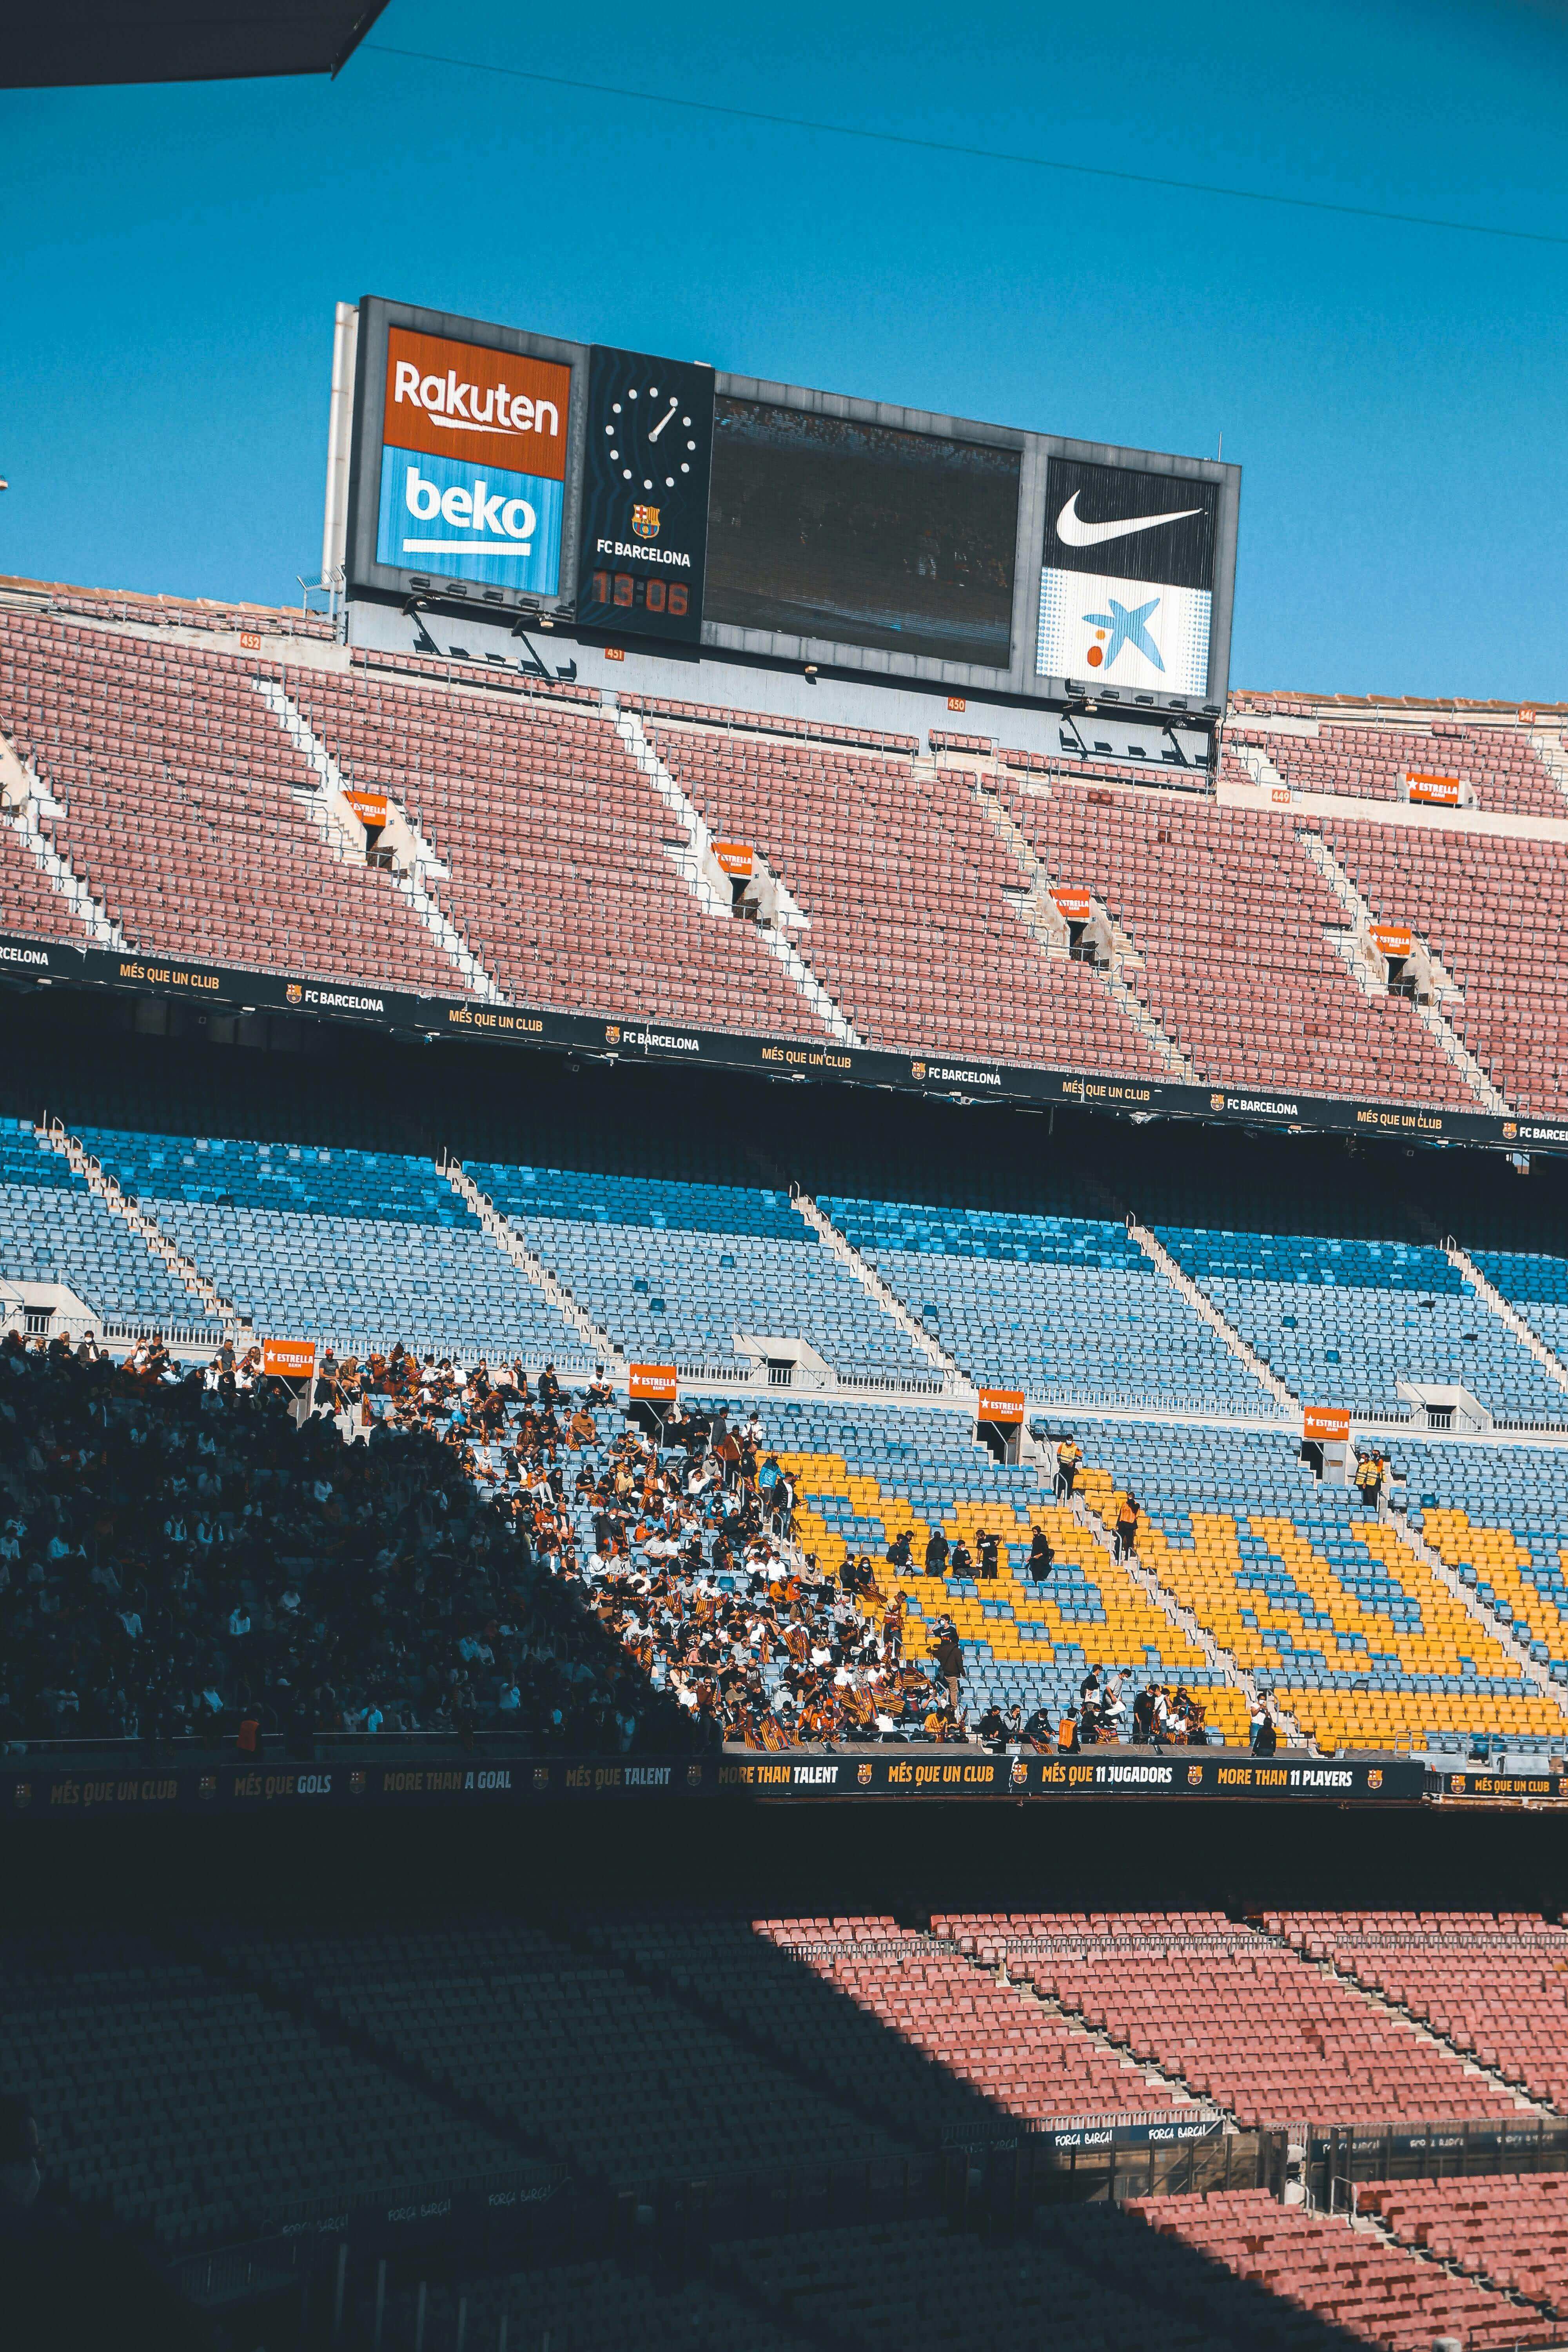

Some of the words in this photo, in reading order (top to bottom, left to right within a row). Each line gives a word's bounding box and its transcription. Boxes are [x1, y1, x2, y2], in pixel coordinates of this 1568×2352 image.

[395, 361, 558, 436] Rakuten
[405, 466, 536, 539] beko
[597, 539, 612, 553] FC
[615, 542, 690, 567] BARCELONA
[242, 635, 260, 649] 452
[608, 648, 622, 660] 451
[949, 699, 964, 710] 450
[1273, 791, 1289, 802] 449
[1419, 782, 1457, 795] ESTRELLA
[120, 963, 144, 978] MÉS
[147, 968, 170, 983] QUE
[173, 972, 188, 985] UN
[191, 975, 219, 989] CLUB
[305, 991, 318, 1003] FC
[320, 993, 383, 1012] BARCELONA
[450, 1008, 472, 1023] MÉS
[475, 1014, 496, 1027] QUE
[499, 1016, 513, 1028] UN
[516, 1019, 542, 1031] CLUB
[624, 1031, 636, 1043] FC
[638, 1033, 699, 1051] BARCELONA
[762, 1047, 784, 1060] MÉS
[786, 1051, 806, 1064] QUE
[809, 1054, 824, 1065] UN
[826, 1055, 851, 1068] CLUB
[929, 1067, 940, 1078] FC
[942, 1068, 1001, 1085] BARCELONA
[1063, 1079, 1082, 1093] MÉS
[1086, 1085, 1106, 1097] QUE
[1109, 1087, 1122, 1098] UN
[1125, 1089, 1149, 1100] CLUB
[1227, 1098, 1239, 1110] FC
[1241, 1100, 1298, 1115] BARCELONA
[1357, 1110, 1378, 1122] MÉS
[1380, 1114, 1399, 1126] QUE
[1402, 1116, 1415, 1127] UN
[1418, 1116, 1442, 1129] CLUB
[1520, 1127, 1532, 1138] FC
[277, 1354, 314, 1364] ESTRELLA
[642, 1377, 675, 1387] ESTRELLA
[991, 1401, 1023, 1411] ESTRELLA
[1316, 1419, 1348, 1429] ESTRELLA
[384, 1773, 423, 1791] MORE
[426, 1772, 462, 1789] THAN
[465, 1772, 474, 1788] A
[478, 1771, 511, 1788] GOAL
[566, 1766, 591, 1787] MÉS
[595, 1769, 621, 1790] QUE
[625, 1768, 670, 1784] TALENT
[719, 1767, 754, 1784] MORE
[758, 1767, 790, 1782] THAN
[794, 1767, 838, 1783] TALENT
[889, 1762, 912, 1782] MÉS
[915, 1766, 940, 1786] QUE
[943, 1766, 961, 1782] UN
[964, 1766, 994, 1782] CLUB
[1042, 1762, 1065, 1782] MÉS
[1069, 1766, 1093, 1786] QUE
[1096, 1766, 1105, 1782] 11
[1108, 1767, 1172, 1784] JUGADORS
[1218, 1769, 1252, 1784] MORE
[1256, 1770, 1287, 1785] THAN
[1291, 1770, 1300, 1785] 11
[1303, 1771, 1352, 1786] PLAYERS
[50, 1780, 80, 1804] MÉS
[83, 1781, 114, 1807] QUE
[118, 1781, 138, 1801] UN
[142, 1780, 177, 1800] CLUB
[235, 1772, 261, 1796] MÉS
[265, 1775, 294, 1800] QUE
[298, 1775, 331, 1793] GOLS
[1475, 1777, 1492, 1791] MÉS
[1494, 1780, 1512, 1793] QUE
[1514, 1781, 1526, 1791] UN
[1529, 1781, 1549, 1792] CLUB
